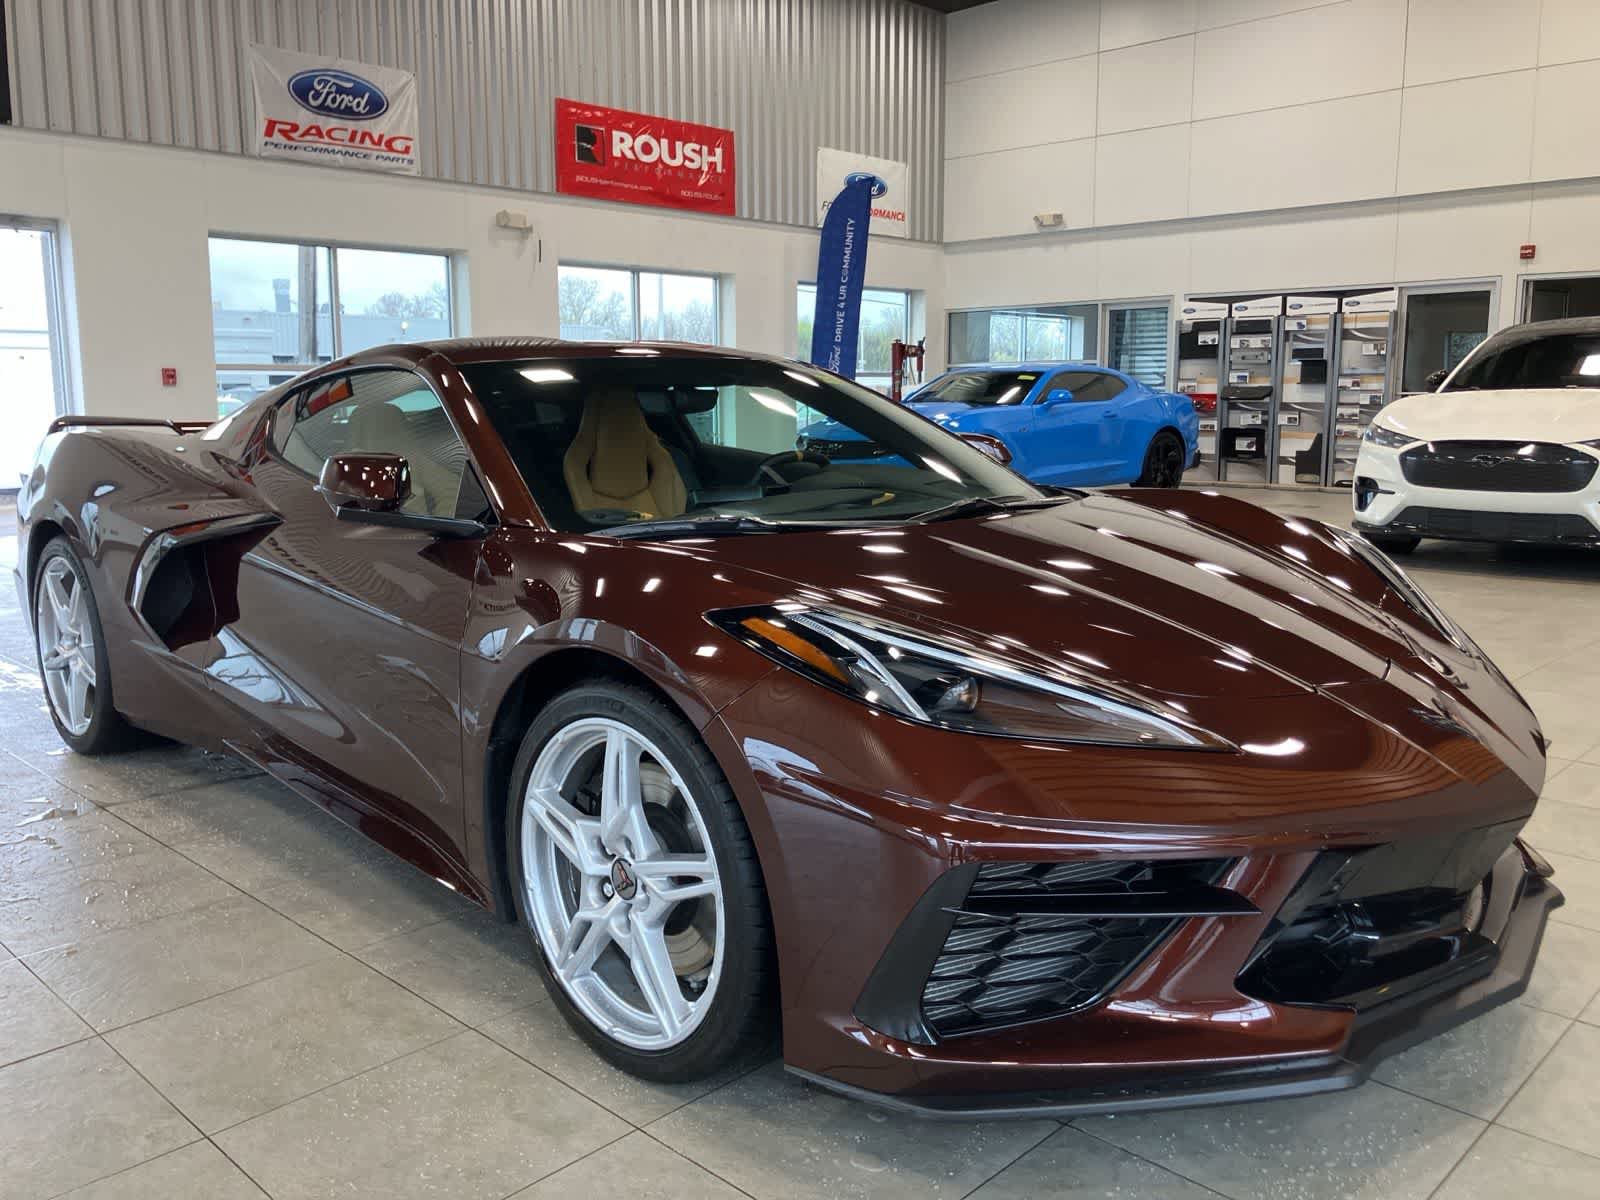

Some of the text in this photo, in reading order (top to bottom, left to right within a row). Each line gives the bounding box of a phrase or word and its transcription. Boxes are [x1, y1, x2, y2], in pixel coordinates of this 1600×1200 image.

[308, 75, 371, 114] Ford
[263, 118, 414, 155] RACING
[264, 141, 415, 165] PERFORMANCE PARTS
[612, 130, 723, 173] ROUSH
[840, 217, 856, 284] COMMUNITY
[838, 285, 848, 300] UR
[834, 311, 846, 343] DRIVE
